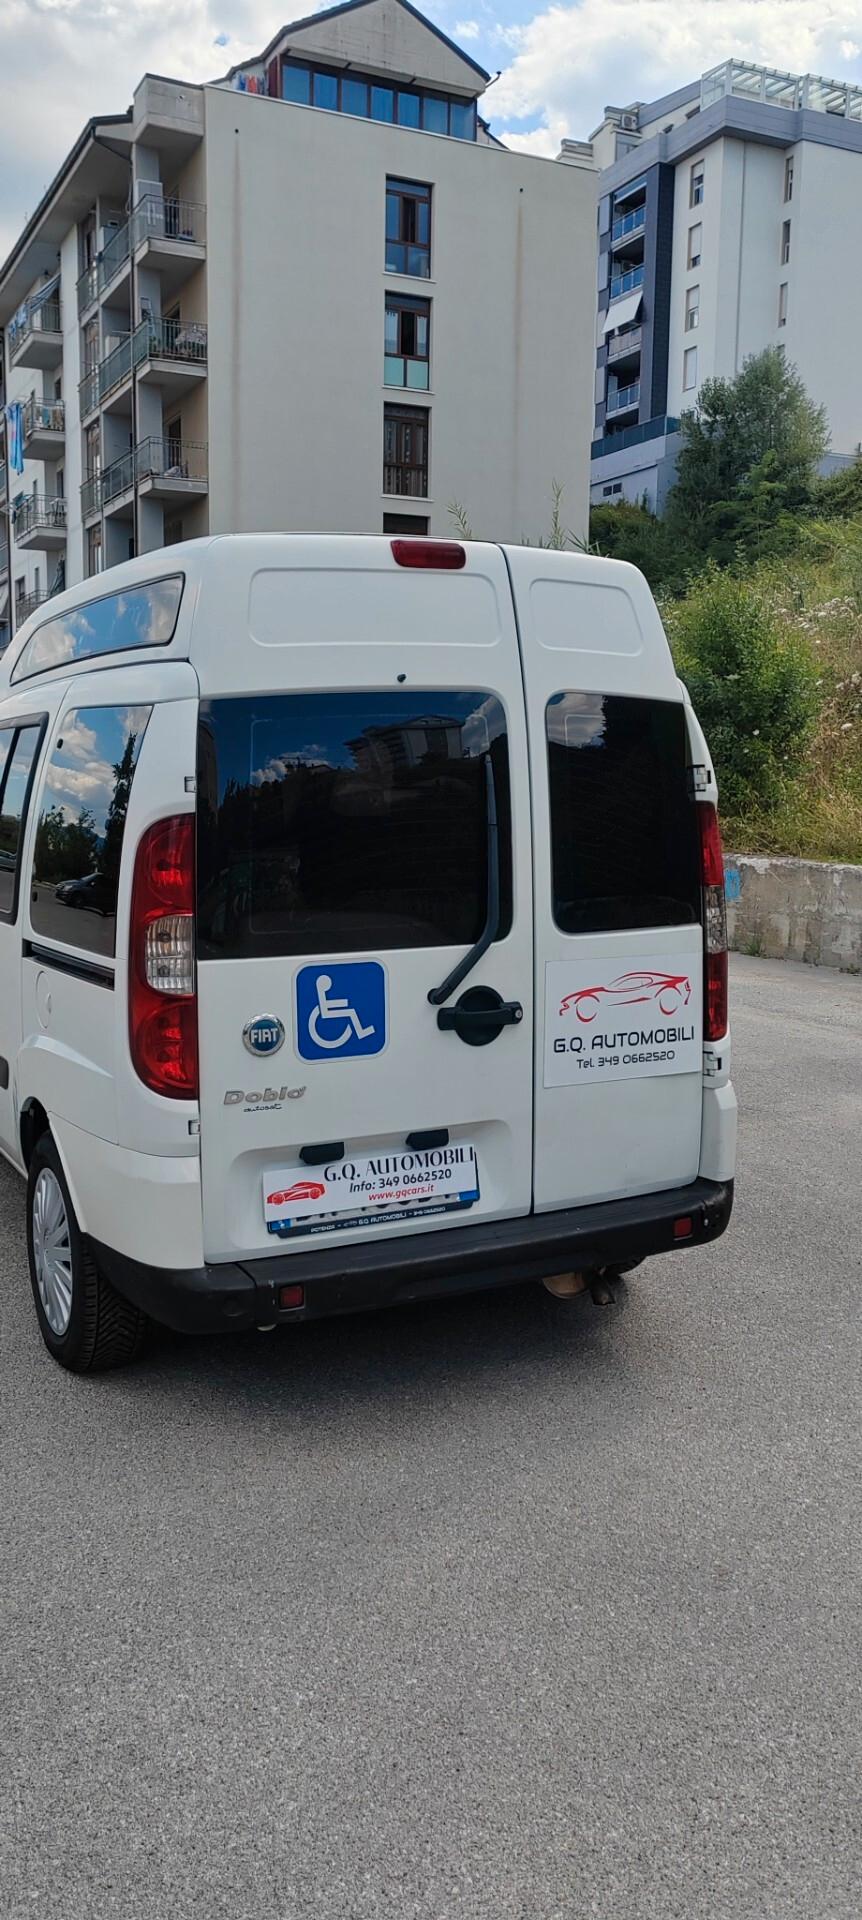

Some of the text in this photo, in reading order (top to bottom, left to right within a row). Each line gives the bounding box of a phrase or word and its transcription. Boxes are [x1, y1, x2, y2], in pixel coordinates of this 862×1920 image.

[250, 1028, 278, 1043] FIAT
[553, 1026, 695, 1053] G.Q. AUTOMOBILI
[576, 1050, 676, 1069] Tel. 349 0662520
[324, 1146, 474, 1182] G.Q. AUTOMOBILI
[350, 1168, 452, 1193] Info: 349 0662520
[368, 1183, 434, 1201] www.gqcars.it
[370, 1212, 407, 1223] AUTOMOBILI
